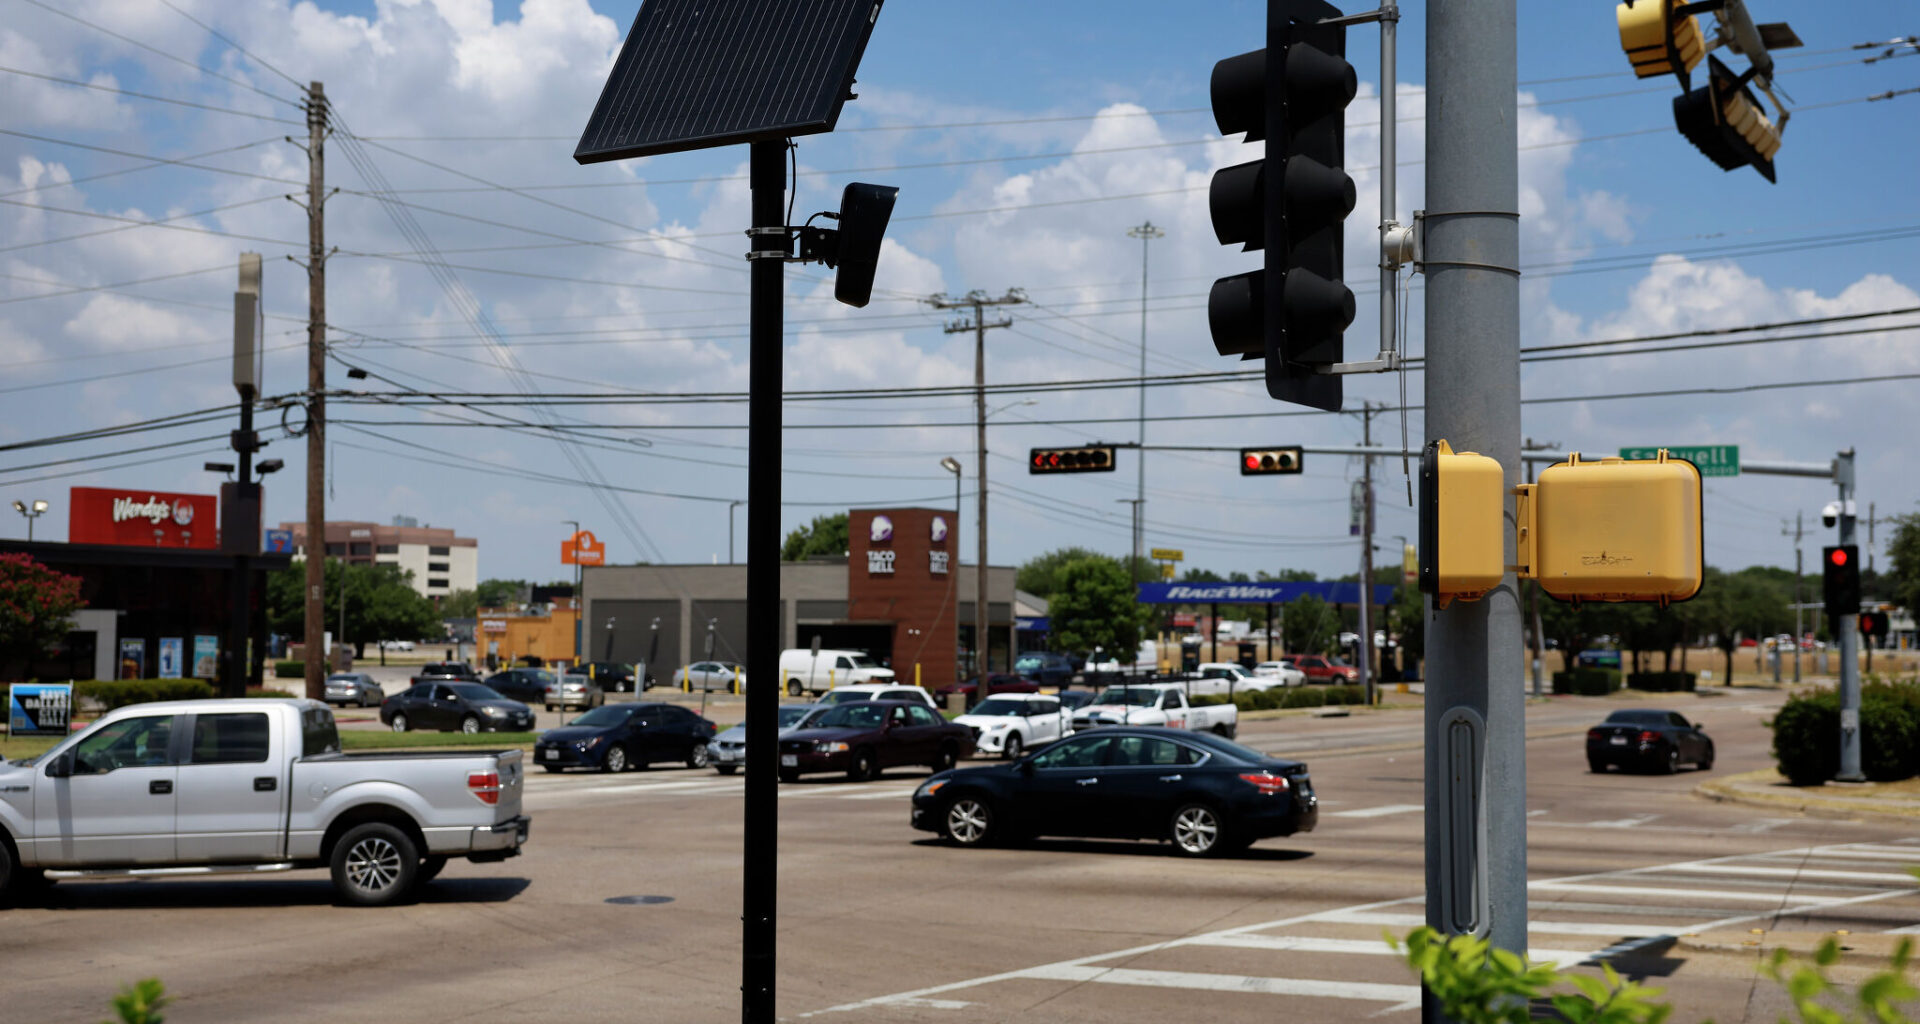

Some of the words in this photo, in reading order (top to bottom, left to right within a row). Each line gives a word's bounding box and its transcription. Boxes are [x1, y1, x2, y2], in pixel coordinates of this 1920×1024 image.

[113, 496, 170, 524] Wendy's
[867, 550, 895, 562] TACO
[929, 550, 949, 562] TACO
[868, 561, 895, 573] BELL
[930, 561, 948, 573] BELL
[40, 689, 67, 699] SAVE
[25, 698, 67, 709] DALLAS
[39, 708, 66, 717] CITY
[39, 716, 65, 727] HALL
